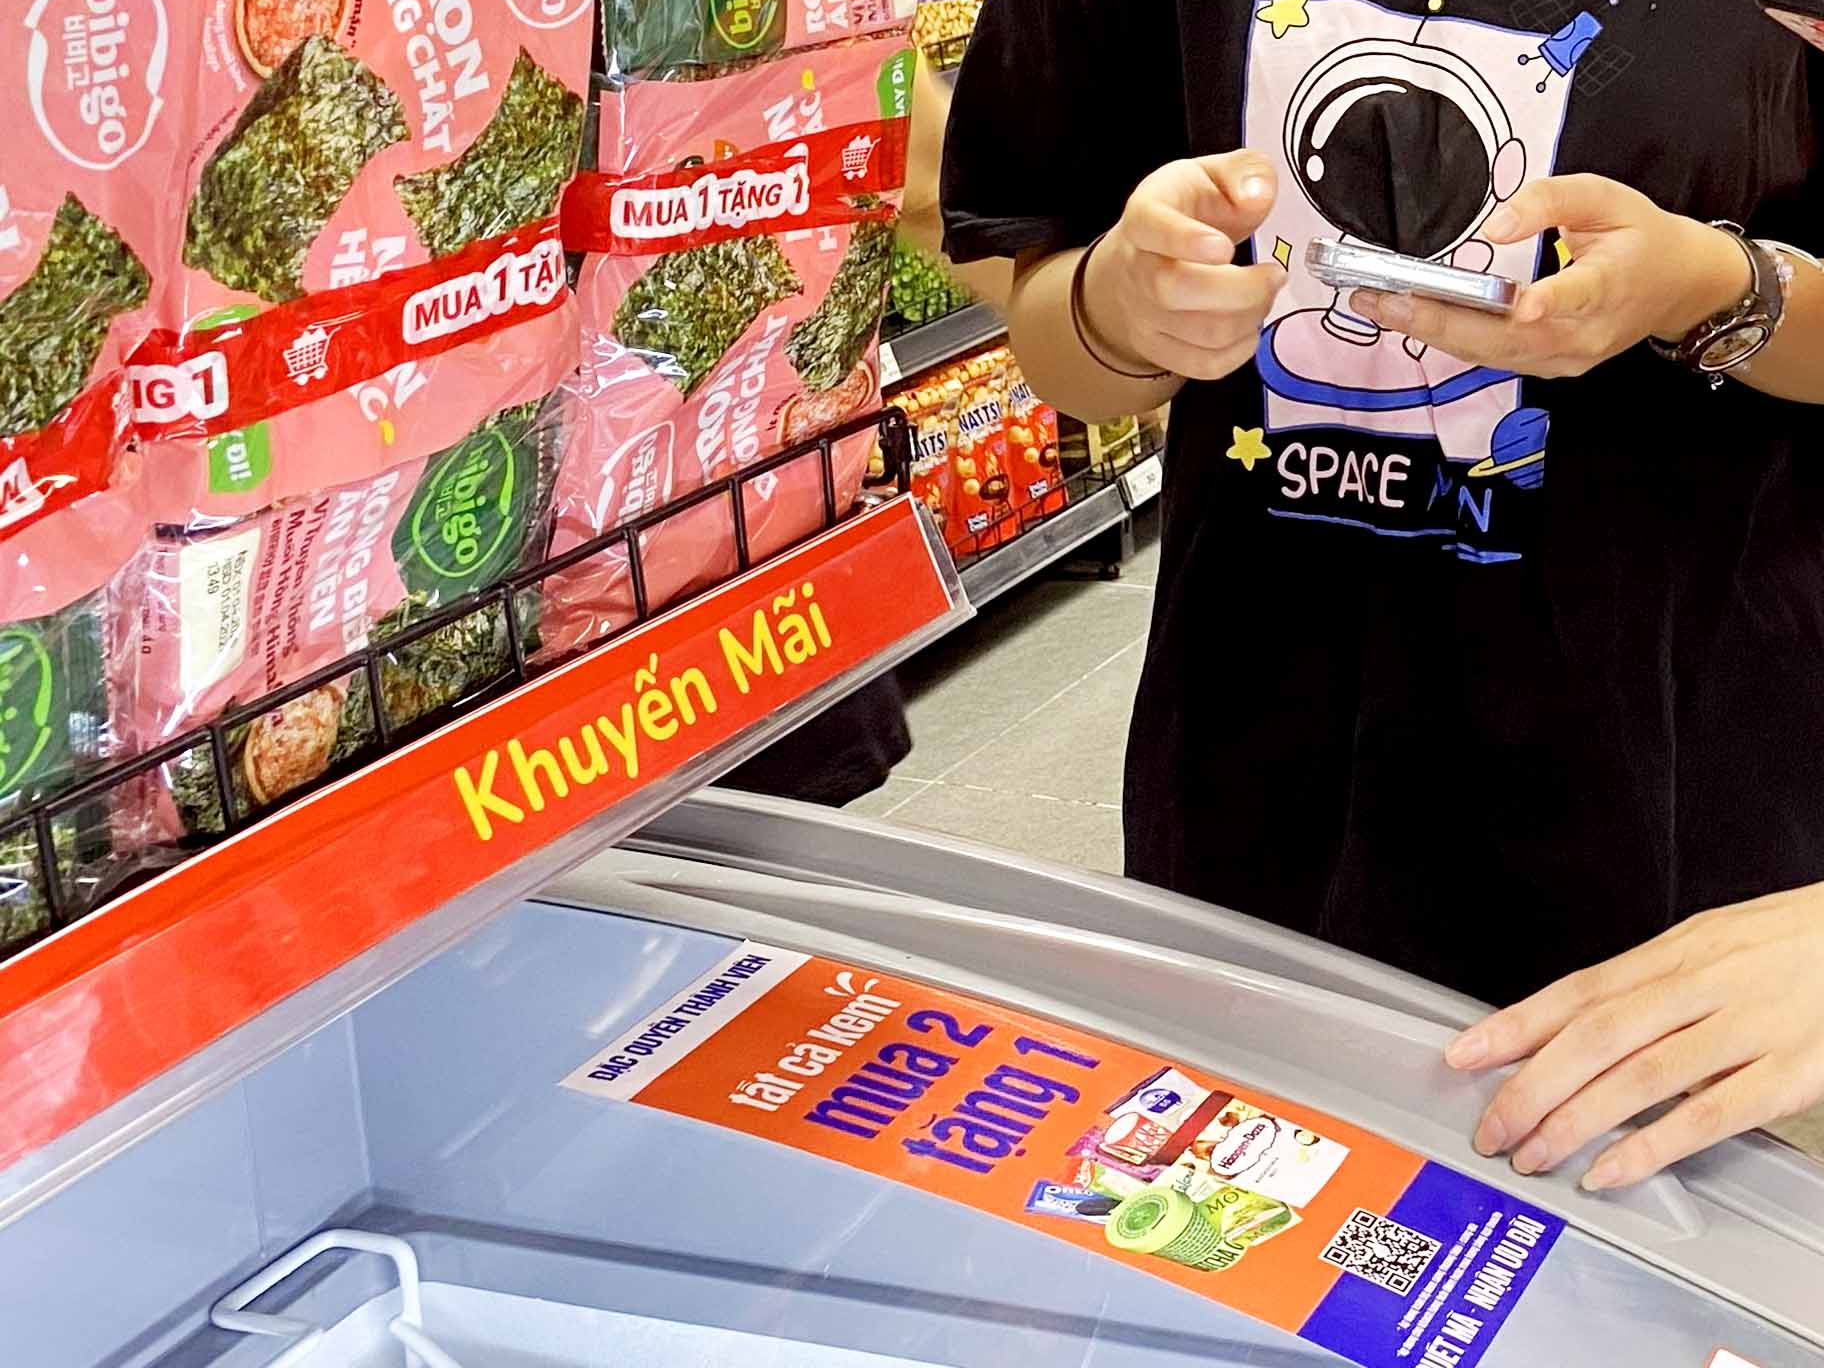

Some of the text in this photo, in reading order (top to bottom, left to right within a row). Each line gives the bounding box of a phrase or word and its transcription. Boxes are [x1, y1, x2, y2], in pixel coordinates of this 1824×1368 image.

[852, 6, 865, 26] Vị
[621, 174, 806, 229] MUA 1 TẶNG 1
[414, 266, 509, 332] MUA 1
[190, 365, 214, 406] 1
[1275, 441, 1412, 509] SPACE
[452, 582, 833, 842] Khuyến Mãi
[623, 1015, 683, 1063] QUYỀN
[672, 975, 738, 1024] THÀNH
[733, 953, 772, 987] VIÊN
[727, 989, 904, 1113] tất cả kem
[803, 1008, 995, 1141] mua 2
[901, 1035, 1102, 1175] tặng 1
[1489, 1238, 1530, 1270] ƯU
[1504, 1213, 1547, 1248] ĐÃI
[1463, 1260, 1517, 1313] NHẬN
[1440, 1309, 1485, 1346] MÃ
